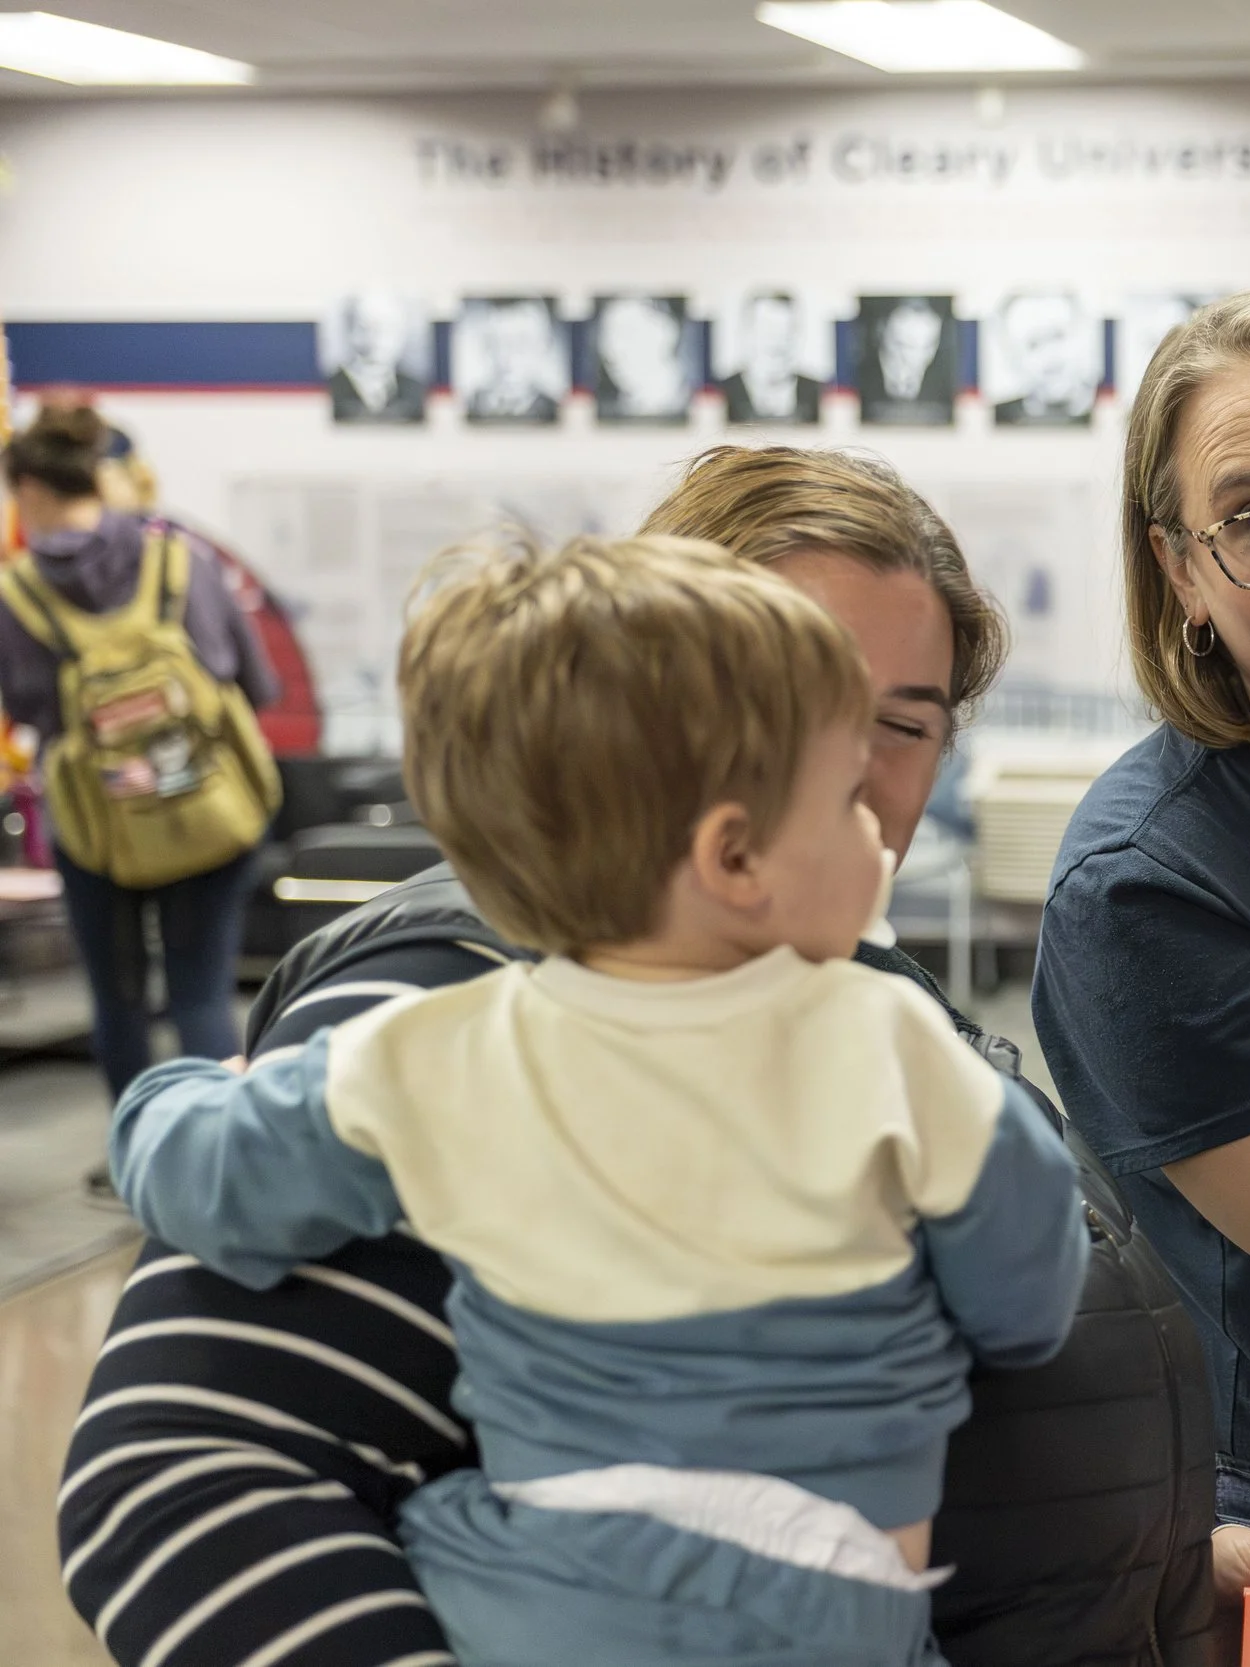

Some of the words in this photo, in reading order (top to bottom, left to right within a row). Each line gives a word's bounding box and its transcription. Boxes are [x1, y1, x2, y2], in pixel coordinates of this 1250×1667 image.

[413, 132, 513, 188] The
[528, 128, 737, 194] History
[750, 128, 819, 188] of
[828, 130, 1018, 192] Cleary
